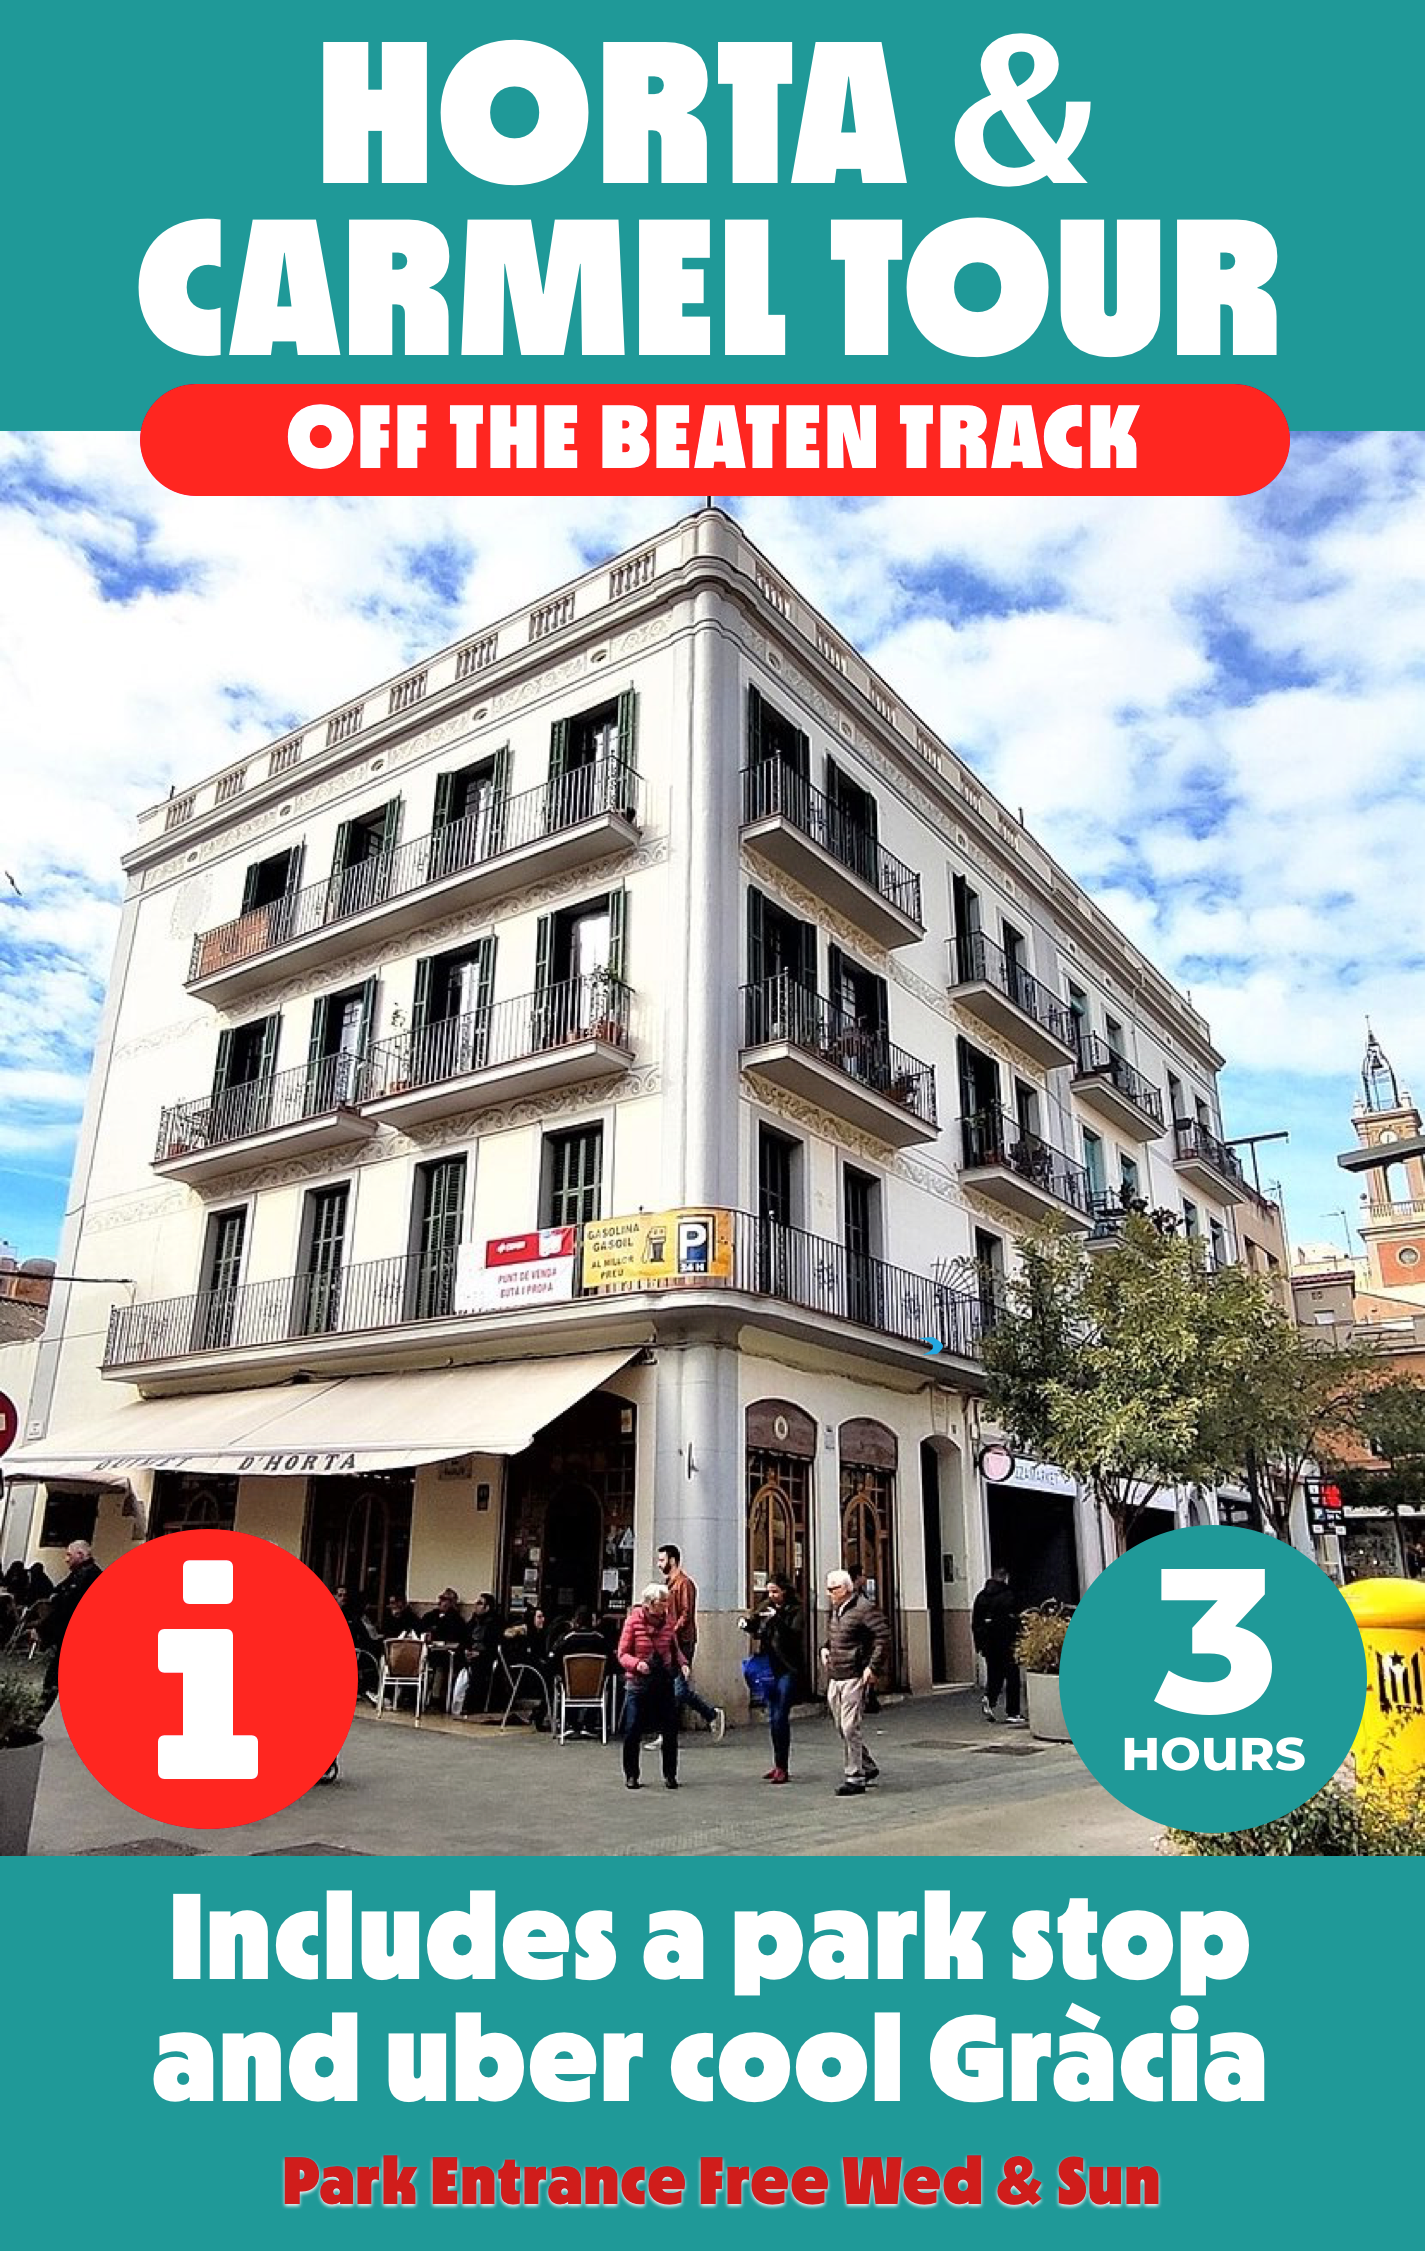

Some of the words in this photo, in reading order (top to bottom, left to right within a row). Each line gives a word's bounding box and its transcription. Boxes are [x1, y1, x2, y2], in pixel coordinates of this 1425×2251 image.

[587, 1224, 639, 1241] GASOLINA
[592, 1237, 633, 1252] GASOIL
[679, 1223, 707, 1261] P
[591, 1260, 601, 1269] AL
[603, 1255, 634, 1267] MILLOR
[498, 1272, 518, 1284] PUNT
[519, 1270, 530, 1282] DE
[531, 1267, 557, 1280] VENDA
[600, 1269, 624, 1280] PREU
[238, 1453, 356, 1471] D'HORTA
